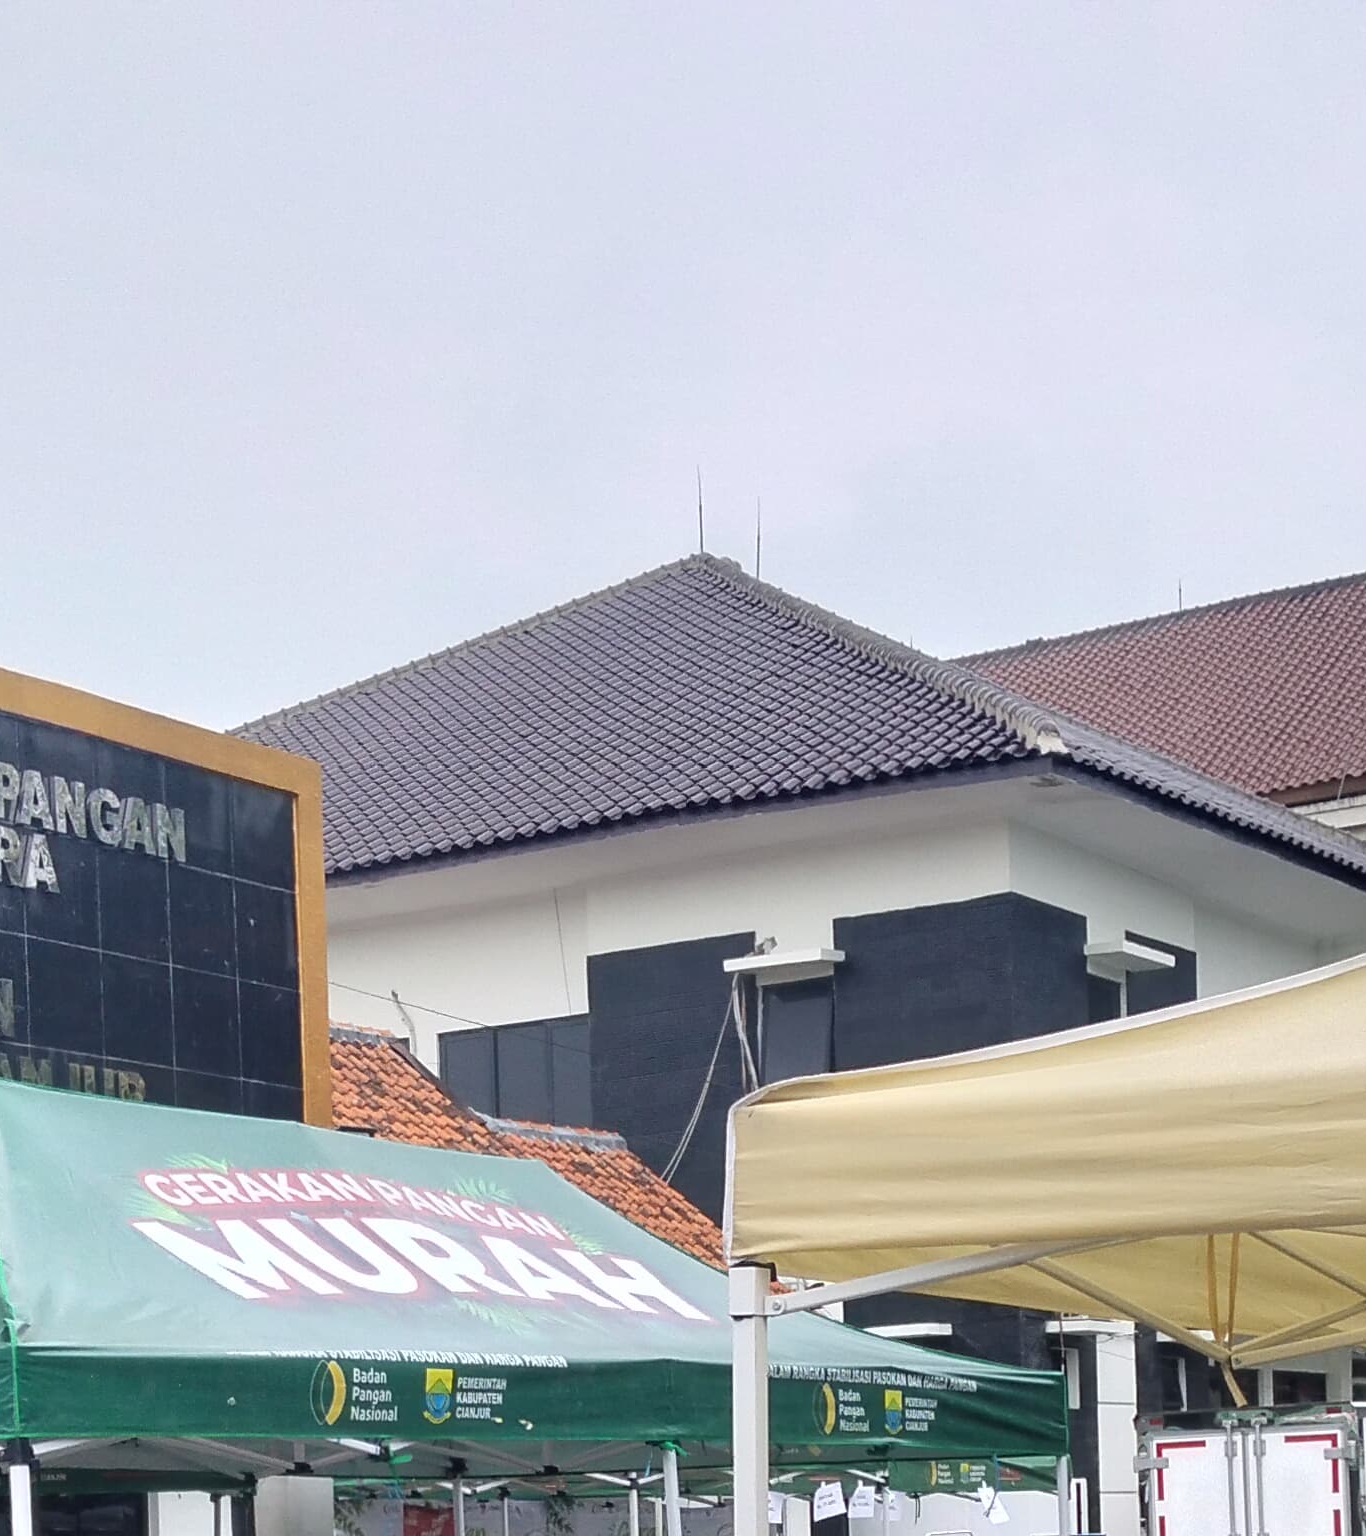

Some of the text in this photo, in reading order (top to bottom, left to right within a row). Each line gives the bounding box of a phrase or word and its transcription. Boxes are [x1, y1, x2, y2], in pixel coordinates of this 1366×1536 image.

[144, 1172, 565, 1241] GERAKAN PANGAN
[133, 1218, 711, 1321] MURAH
[353, 1368, 387, 1384] Badan
[457, 1377, 507, 1390] PEMERINTAH
[352, 1386, 392, 1405] Pangan
[456, 1392, 503, 1405] KABUPATEN
[838, 1389, 861, 1402] Badan
[350, 1405, 398, 1422] Nasional
[456, 1406, 492, 1420] CIANJUR
[839, 1404, 865, 1418] Pangan
[839, 1419, 870, 1433] Nasional
